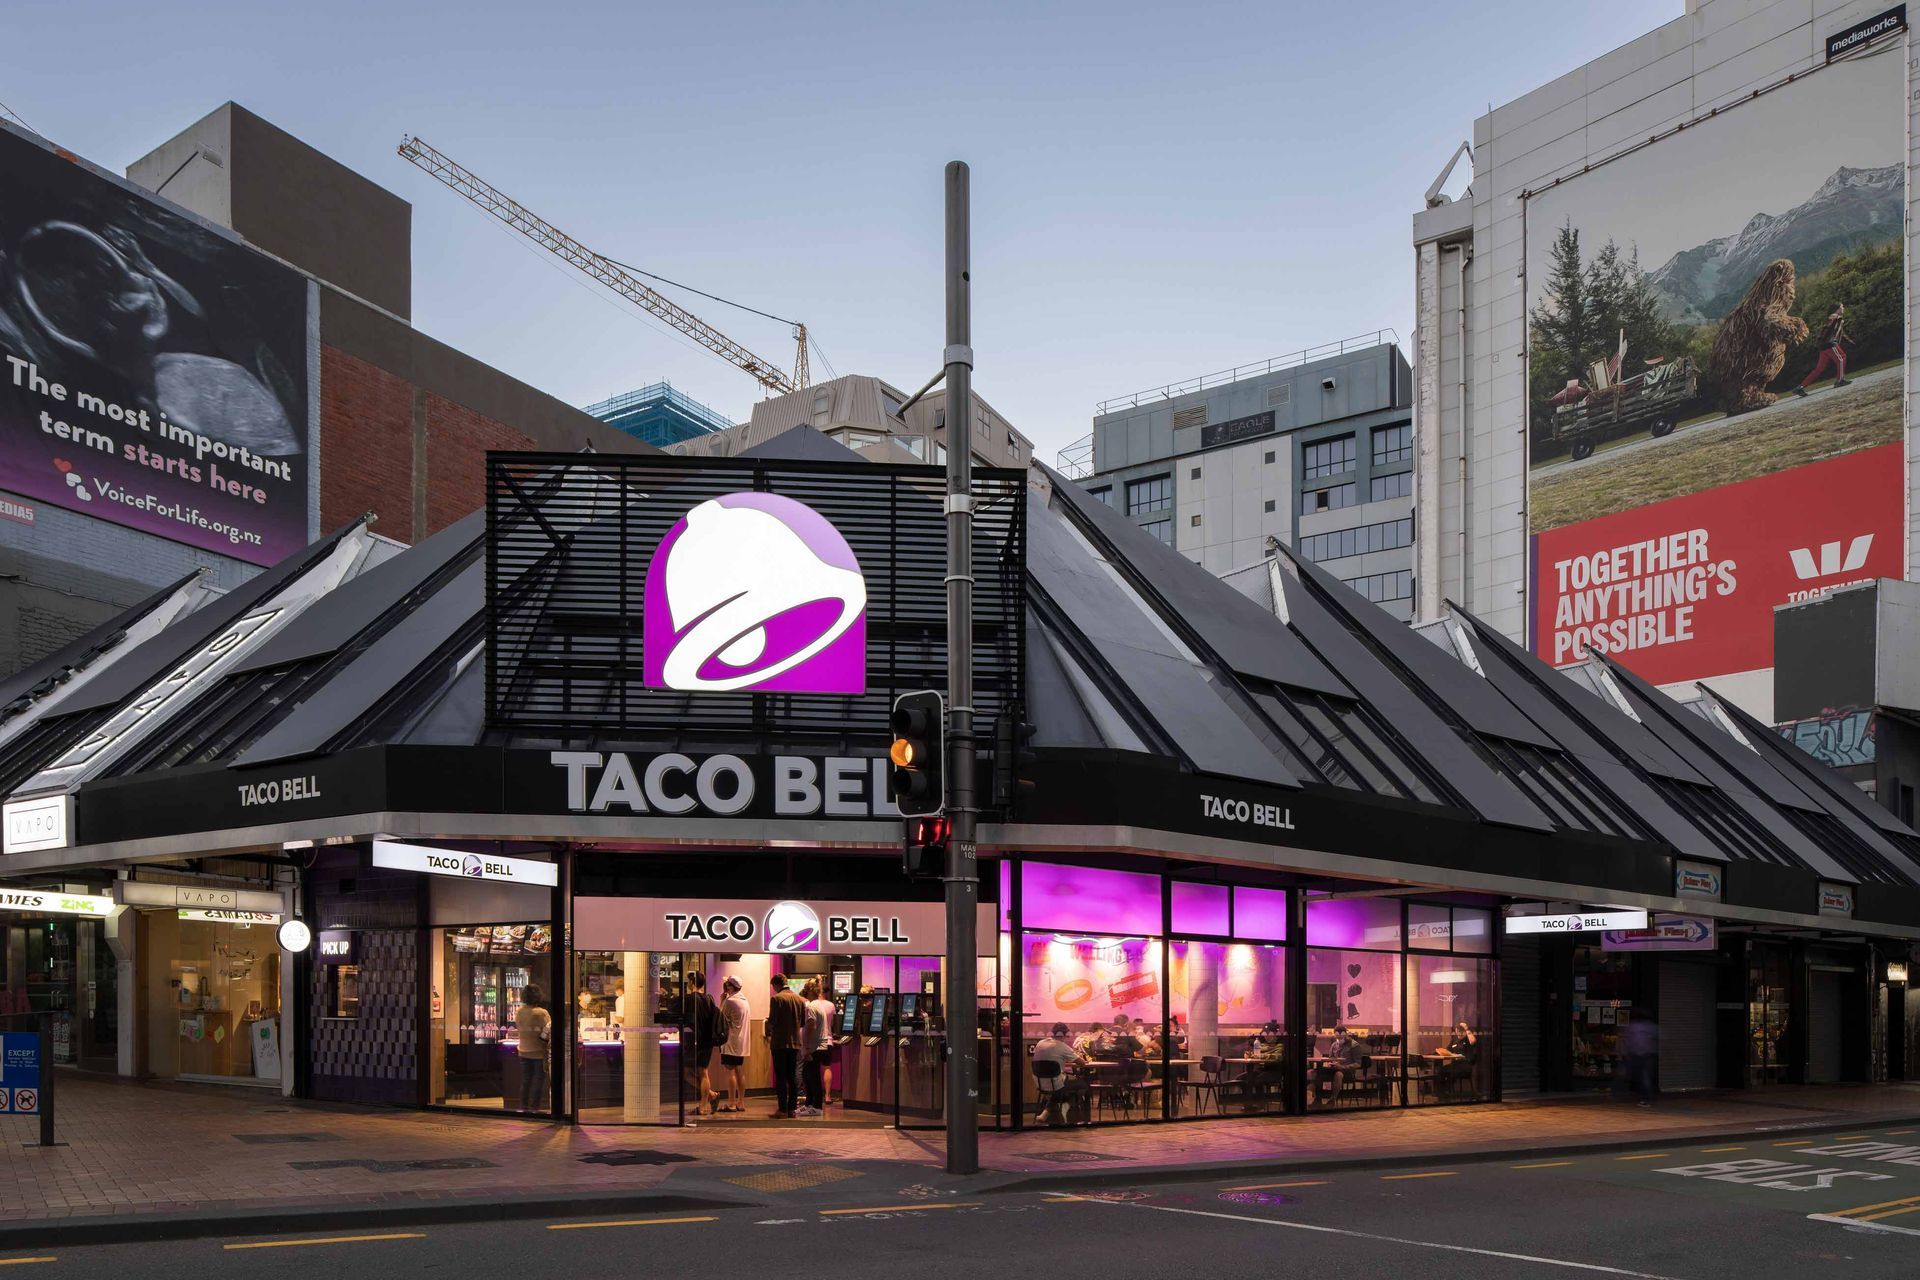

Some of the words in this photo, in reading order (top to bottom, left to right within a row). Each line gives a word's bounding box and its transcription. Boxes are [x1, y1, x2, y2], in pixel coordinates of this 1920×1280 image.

[1831, 15, 1898, 52] mediaworks
[6, 355, 67, 401] The
[77, 391, 151, 432] most
[159, 413, 292, 481] important
[40, 410, 114, 454] term
[124, 441, 201, 484] starts
[210, 464, 267, 504] here
[94, 477, 262, 545] VoiceForLife.org.nz
[1555, 528, 1709, 593] TOGETHER
[1555, 560, 1737, 629] ANYTHING'S
[1555, 605, 1694, 664] POSSIBLE
[238, 781, 280, 807] TACO
[282, 775, 321, 802] BELL
[550, 751, 755, 816] TACO
[774, 755, 902, 816] BEL
[1200, 795, 1250, 822] TACO
[1253, 803, 1295, 830] BELL
[427, 855, 460, 870] TACO
[485, 862, 513, 876] BELL
[183, 892, 229, 904] VAPO
[966, 884, 972, 892] 3
[665, 915, 755, 942] TACO
[828, 917, 909, 943] BELL
[1541, 919, 1565, 929] TACO
[1584, 917, 1608, 928] BELL
[322, 942, 338, 955] PICK
[339, 941, 349, 954] UP
[8, 1049, 35, 1057] EXCEPT
[1651, 1158, 1896, 1191] BUS
